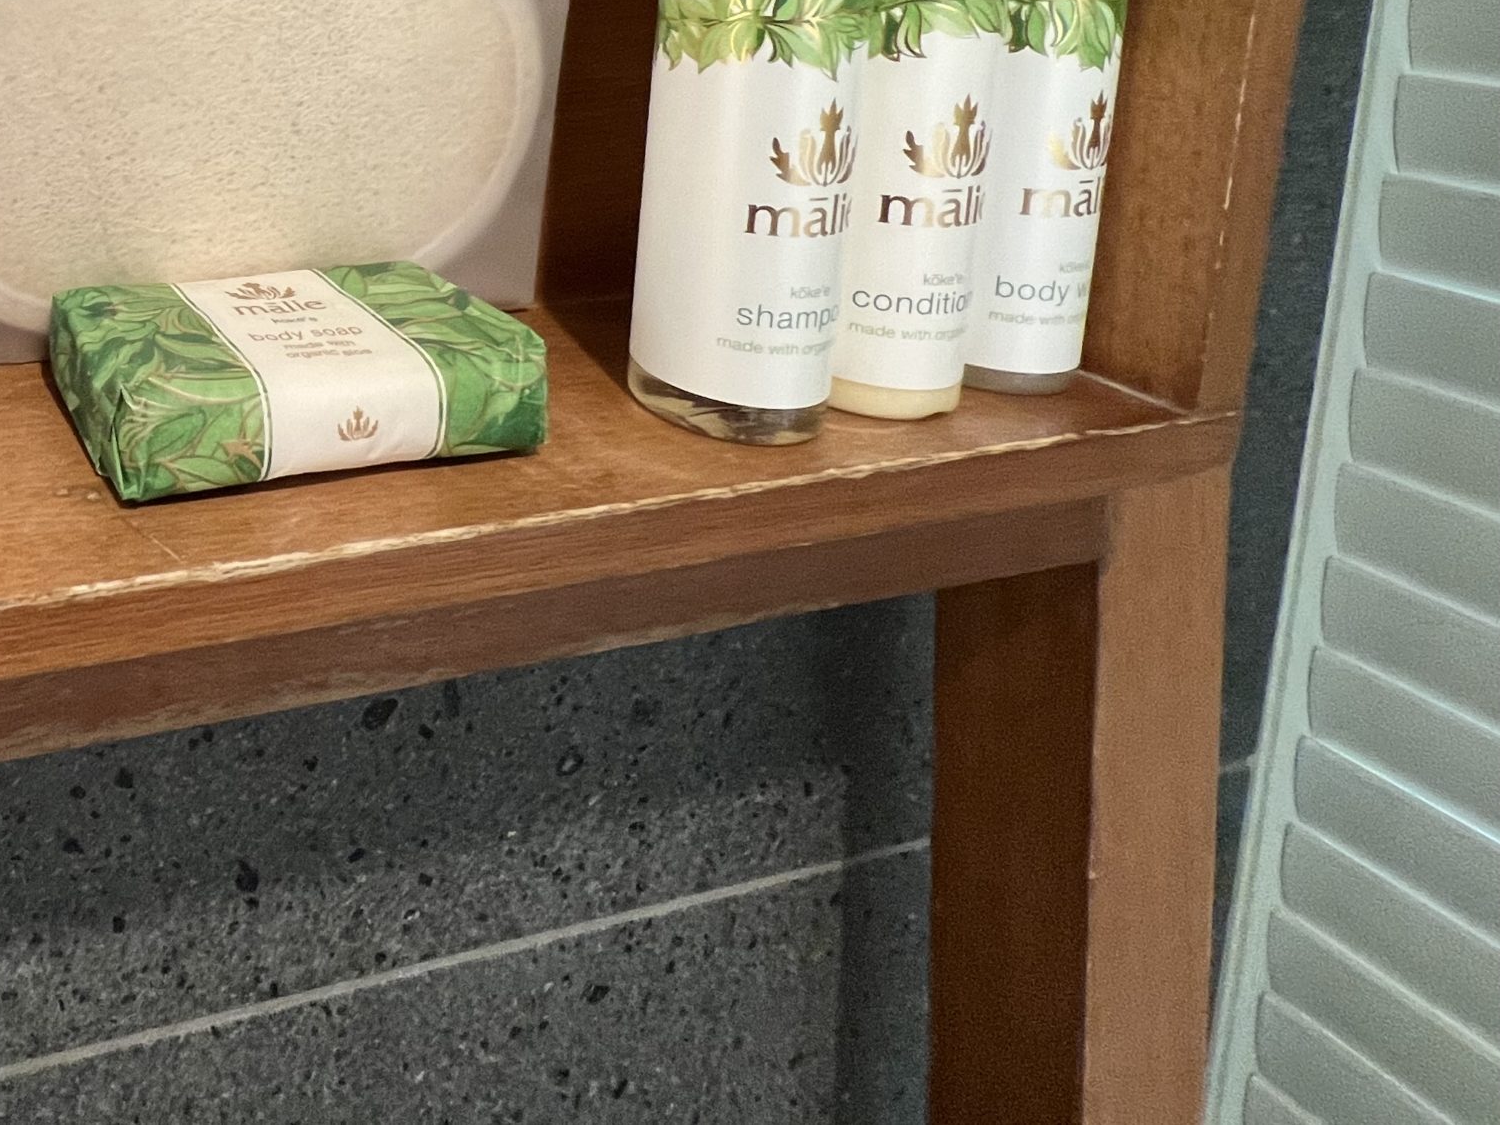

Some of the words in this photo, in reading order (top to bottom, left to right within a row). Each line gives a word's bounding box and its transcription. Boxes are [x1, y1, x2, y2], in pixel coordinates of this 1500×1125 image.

[877, 184, 986, 228] māli
[1019, 176, 1101, 218] māl
[994, 274, 1070, 307] body
[247, 329, 305, 342] body
[310, 325, 364, 338] soap
[848, 321, 896, 339] made
[901, 329, 931, 341] with
[716, 336, 763, 355] made
[768, 343, 800, 356] with
